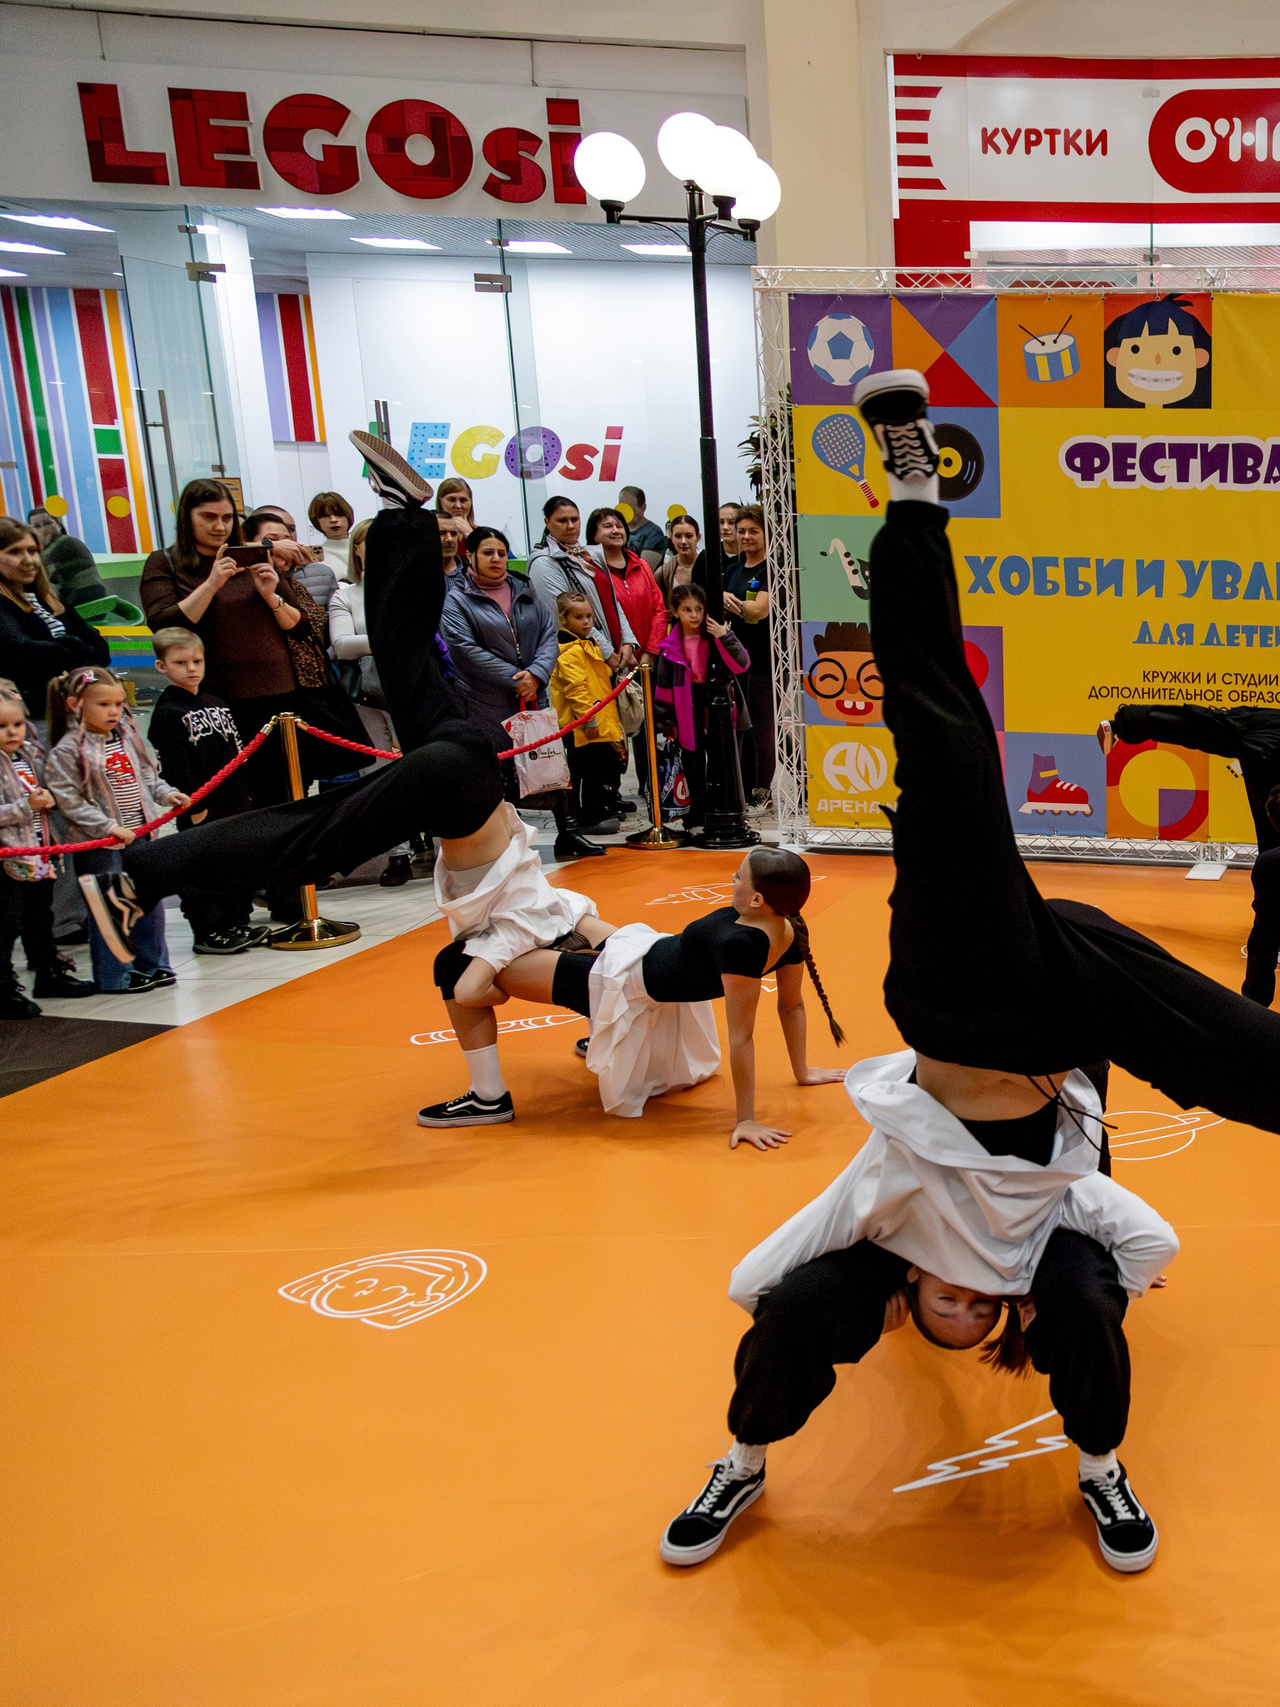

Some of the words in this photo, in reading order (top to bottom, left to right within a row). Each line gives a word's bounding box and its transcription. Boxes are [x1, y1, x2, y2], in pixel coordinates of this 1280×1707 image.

[77, 82, 587, 205] LEGOsi
[980, 126, 1109, 157] КУРТКИ
[963, 555, 1125, 598] ХОББИ
[1135, 558, 1166, 599] И
[1132, 620, 1195, 647] ДЛЯ
[1087, 685, 1223, 702] ДОПОЛНИТЕЛЬНОЕ
[1142, 670, 1202, 685] КРУЖКИ
[1206, 671, 1217, 685] И
[1221, 672, 1280, 688] СТУДИИ
